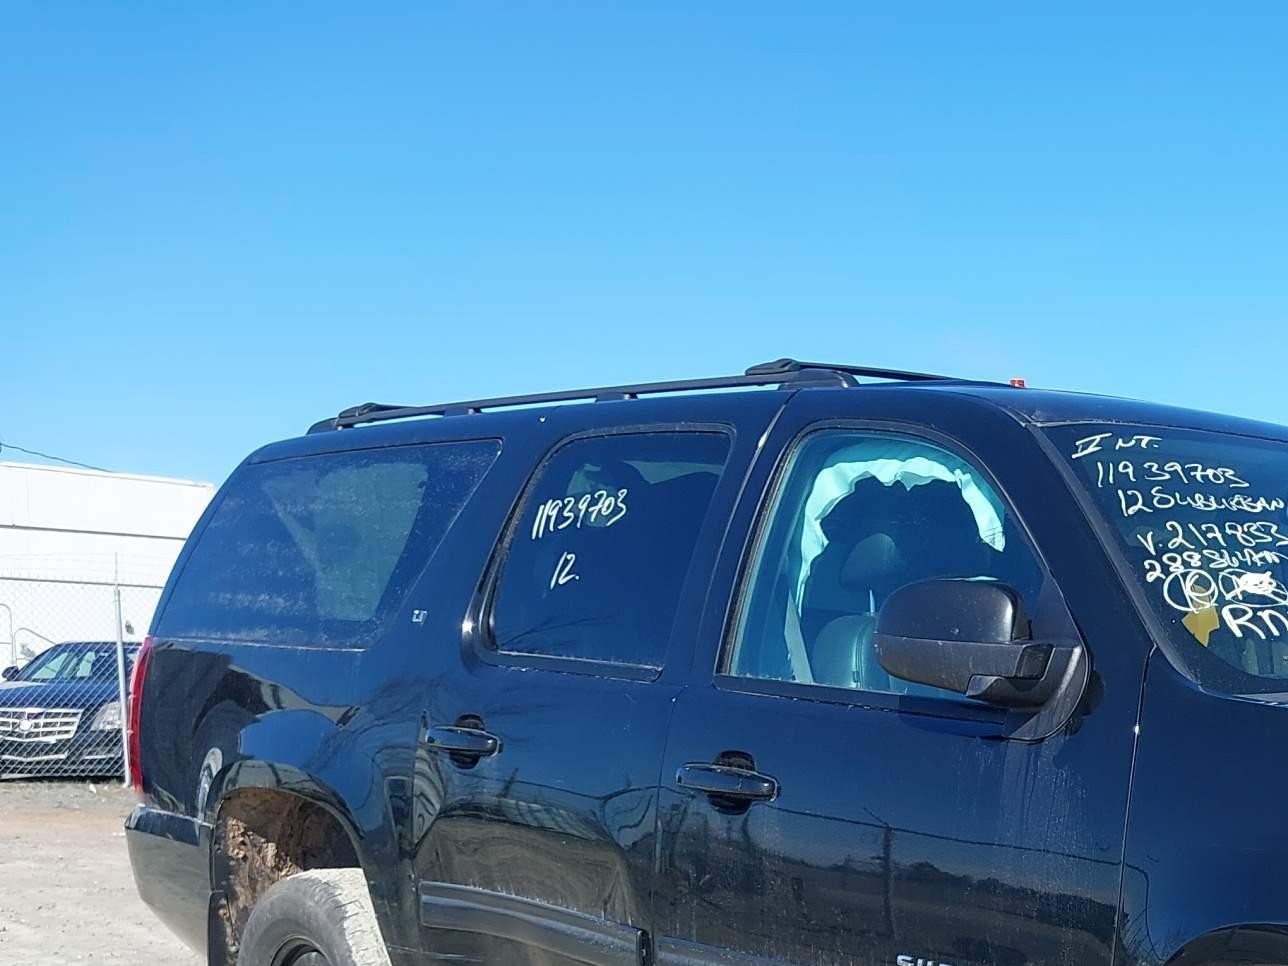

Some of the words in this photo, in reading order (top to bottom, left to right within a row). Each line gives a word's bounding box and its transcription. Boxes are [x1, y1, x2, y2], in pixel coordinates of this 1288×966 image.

[1096, 460, 1250, 488] 11939703
[531, 488, 628, 540] 11939703
[1117, 488, 1153, 517] 12
